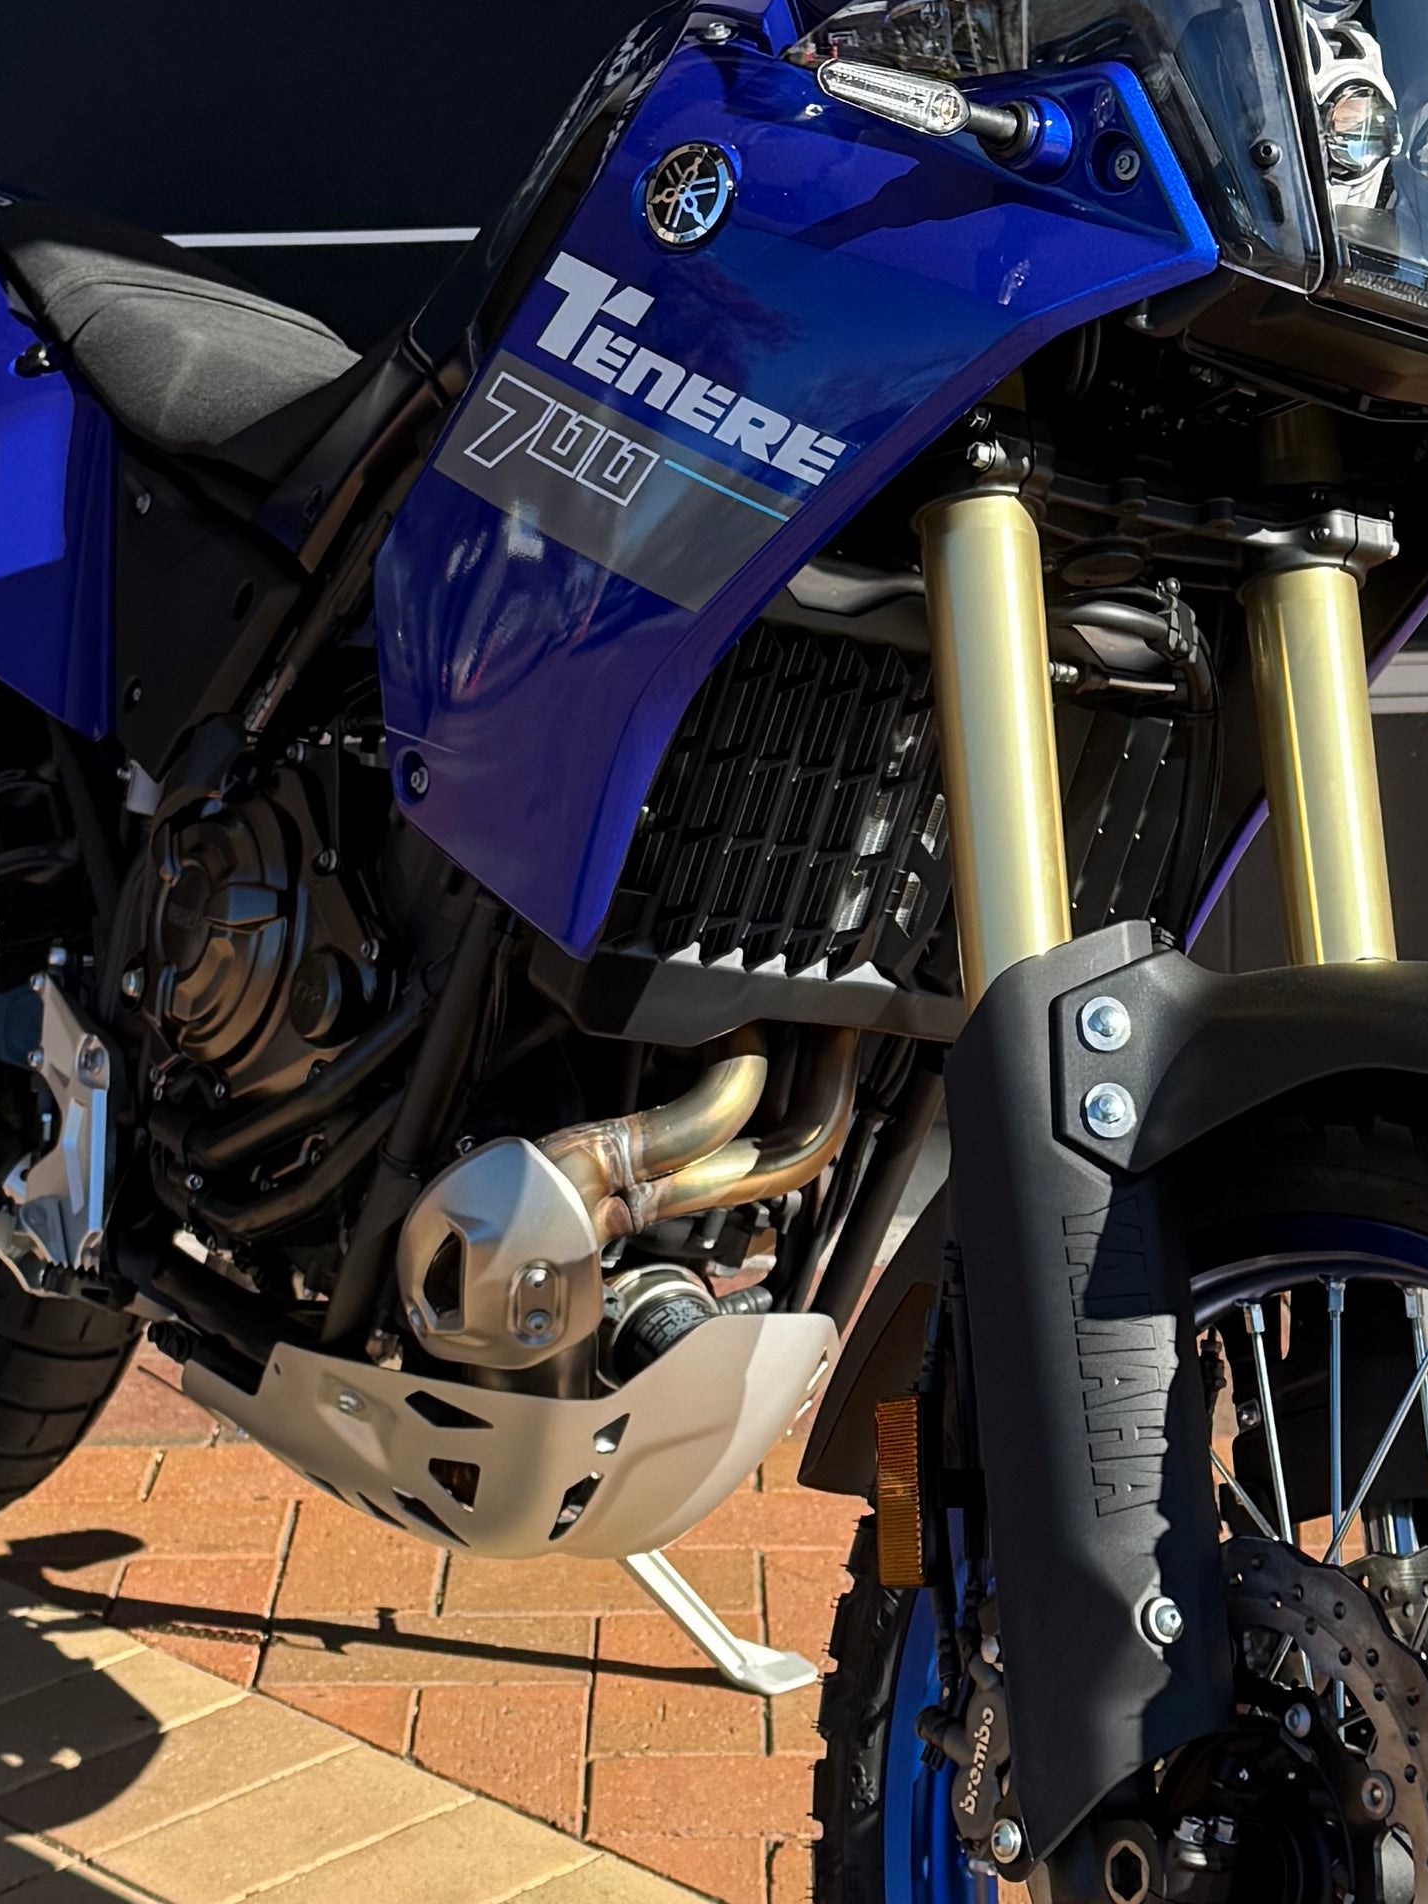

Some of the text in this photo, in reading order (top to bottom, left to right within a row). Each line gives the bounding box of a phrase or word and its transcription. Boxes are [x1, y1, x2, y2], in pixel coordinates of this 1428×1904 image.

[462, 370, 661, 507] 700
[1062, 1194, 1171, 1518] YAMAHA
[958, 1705, 995, 1817] brembo
